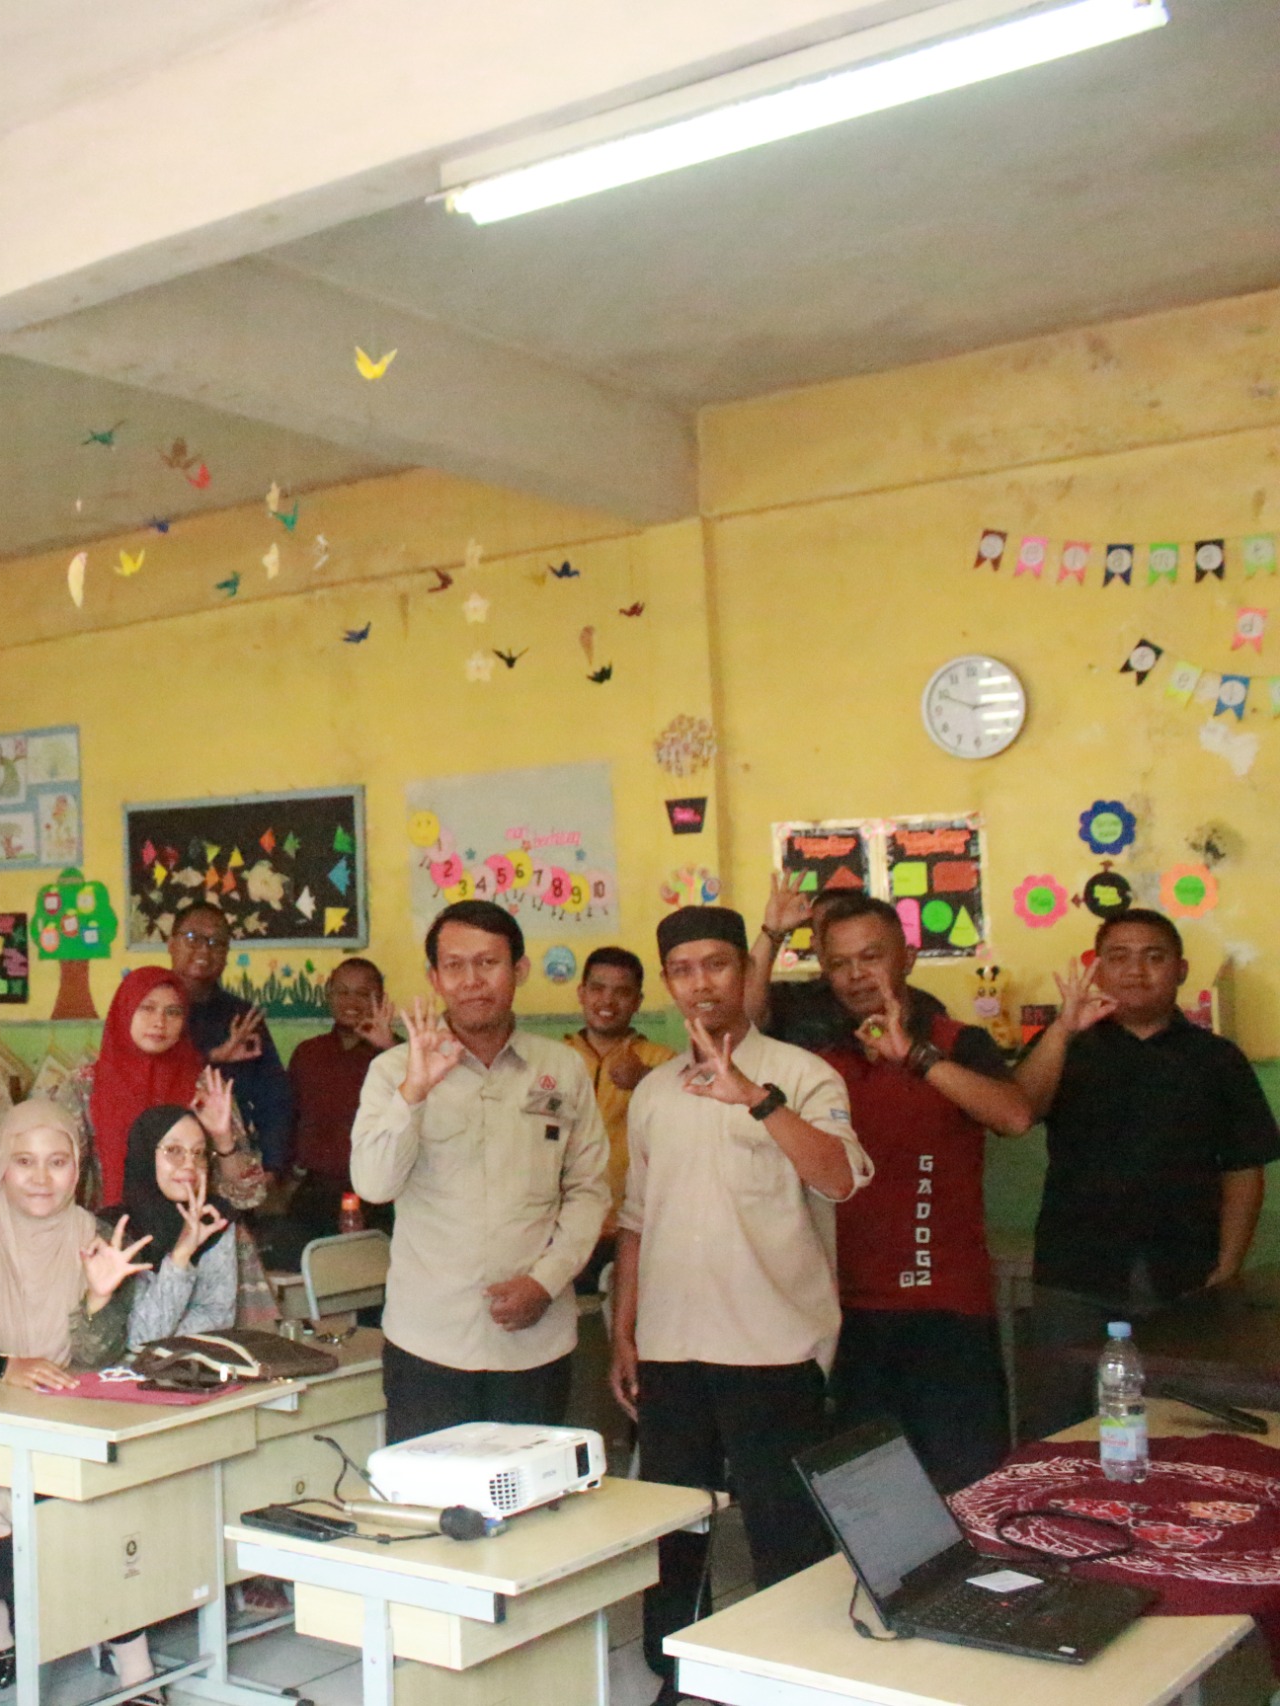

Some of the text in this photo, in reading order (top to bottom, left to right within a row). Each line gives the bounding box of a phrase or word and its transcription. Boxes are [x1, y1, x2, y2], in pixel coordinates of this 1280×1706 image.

[442, 859, 454, 878] 2
[458, 879, 468, 897] 3
[475, 876, 487, 893] 4
[496, 867, 508, 885] 5
[514, 864, 525, 879] 6
[532, 869, 543, 888] 7
[551, 877, 564, 899] 8
[570, 886, 583, 905] 9
[592, 880, 605, 899] 10
[915, 1155, 933, 1267] GADOG
